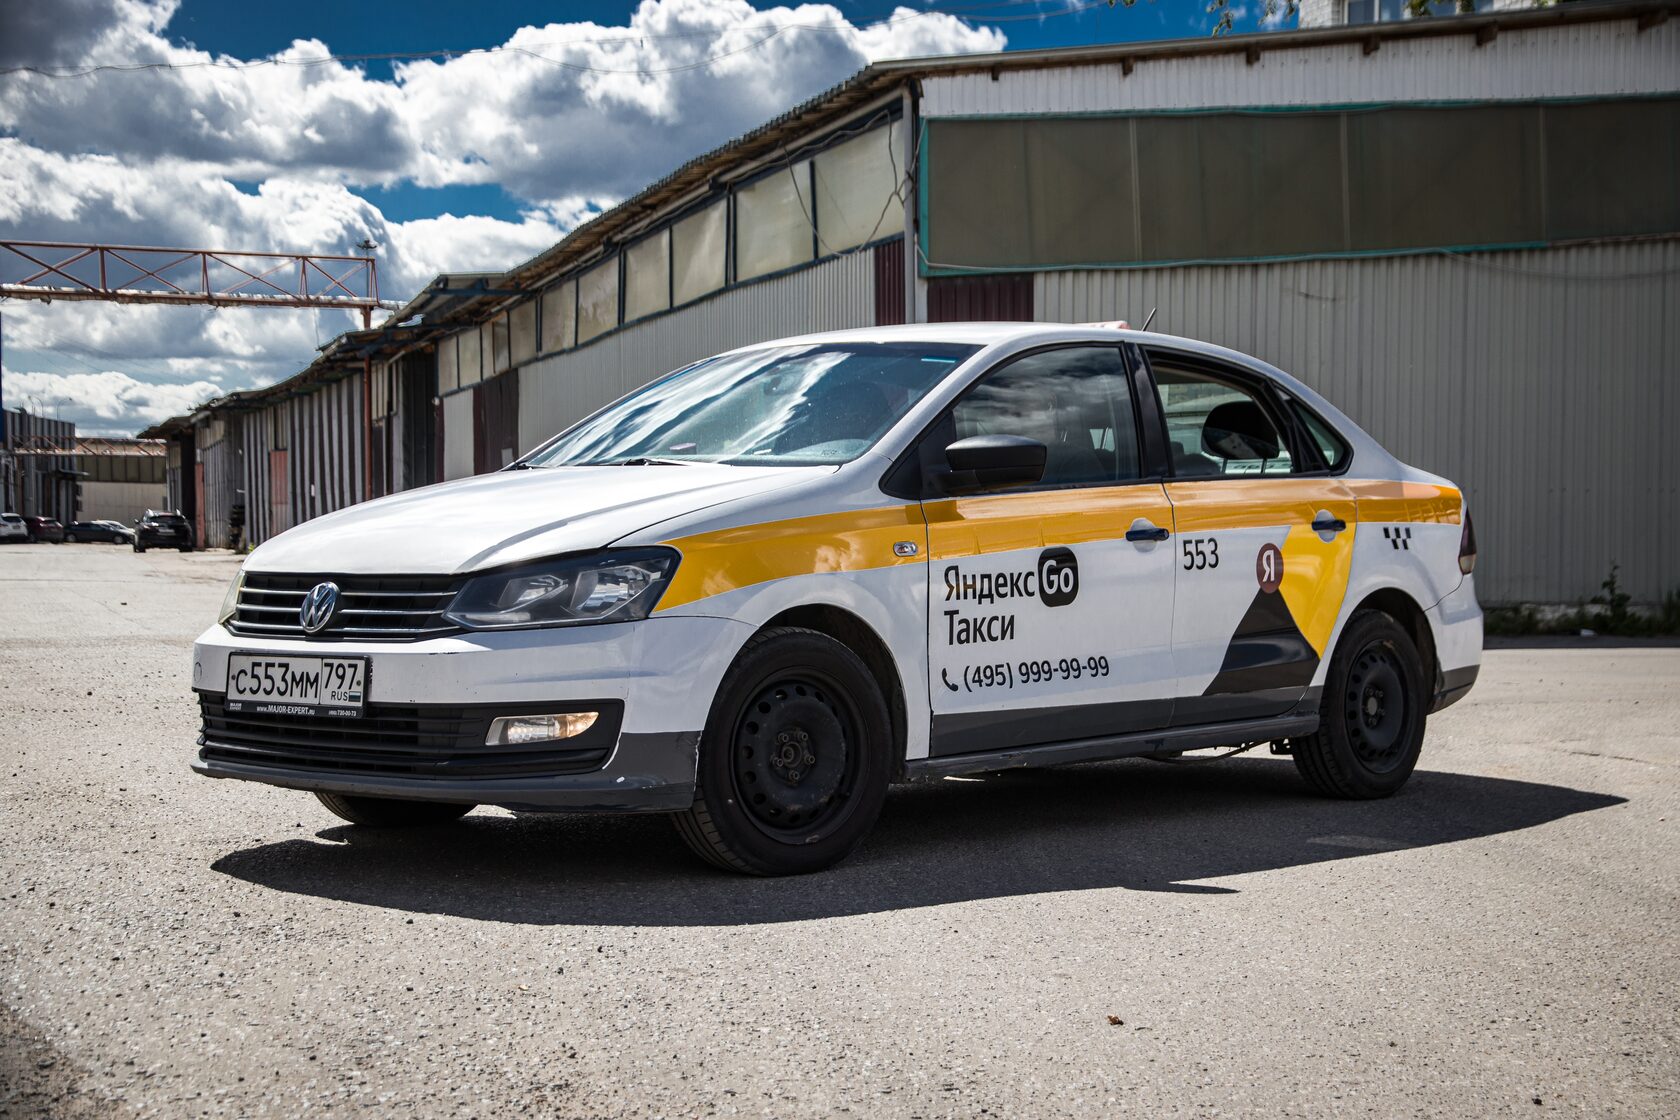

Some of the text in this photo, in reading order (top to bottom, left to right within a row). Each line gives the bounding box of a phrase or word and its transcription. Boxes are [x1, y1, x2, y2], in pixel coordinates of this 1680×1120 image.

[1182, 537, 1220, 571] 553
[1262, 549, 1275, 583] Я
[943, 559, 1075, 605] Яндекс Go
[943, 609, 1015, 646] Такси
[323, 662, 359, 690] 797
[963, 655, 1110, 693] (495) 999-99-99
[330, 690, 348, 702] RUS
